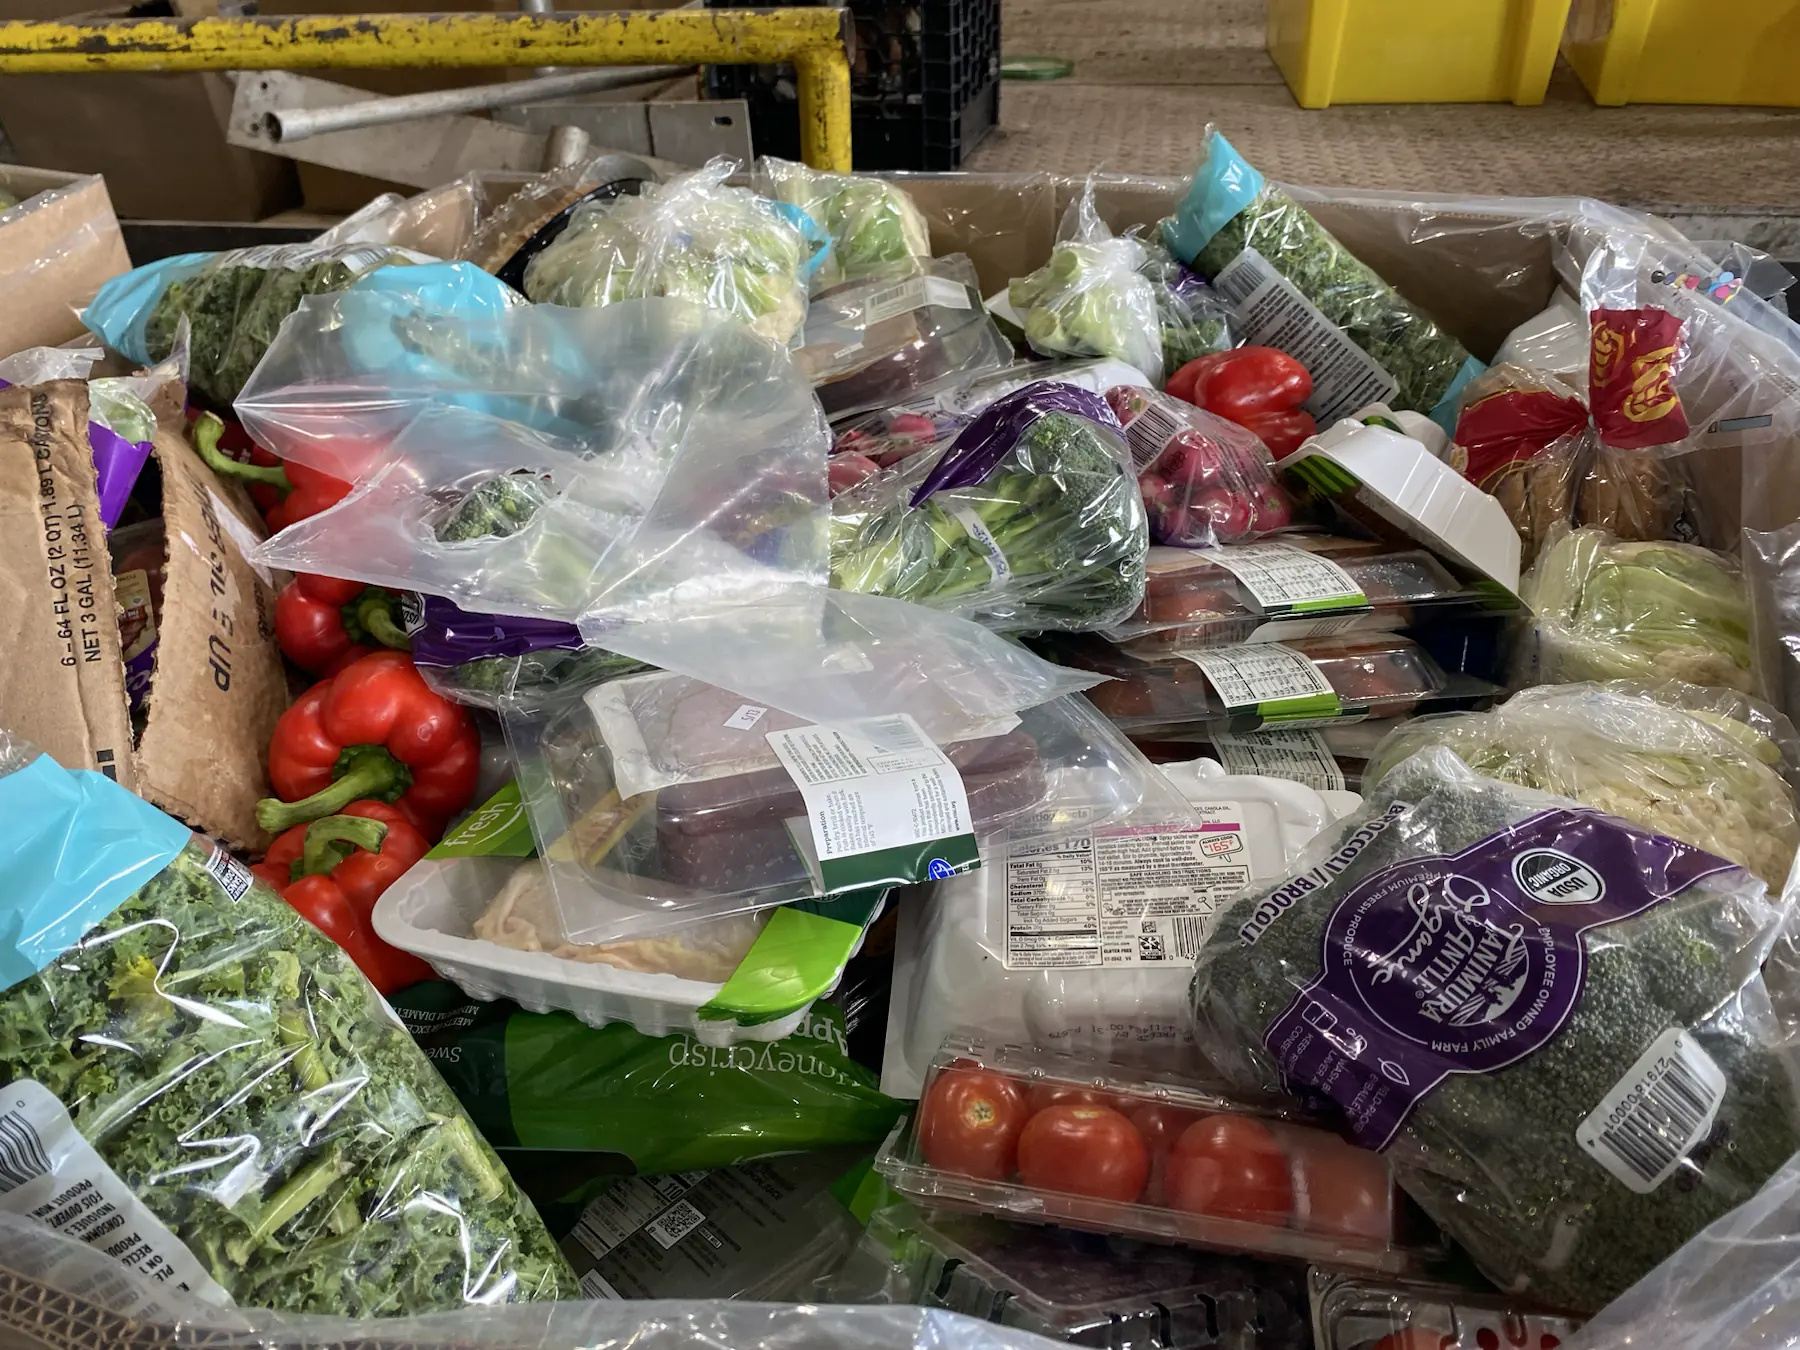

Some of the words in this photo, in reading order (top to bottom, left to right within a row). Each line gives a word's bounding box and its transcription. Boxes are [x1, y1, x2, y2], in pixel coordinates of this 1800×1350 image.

[40, 464, 52, 475] L
[40, 478, 56, 508] 1.89
[66, 504, 84, 521] L)
[45, 515, 62, 542] QT)
[48, 545, 67, 560] (2
[71, 523, 93, 569] (11.34
[50, 564, 66, 589] OZ
[76, 574, 95, 606] GAL
[53, 593, 69, 615] FL
[81, 608, 96, 623] 3
[57, 621, 72, 638] 64
[83, 629, 101, 663] NET
[61, 656, 76, 666] 6
[209, 634, 231, 692] UP
[444, 802, 512, 847] fresh
[820, 811, 833, 854] Preparation
[1389, 872, 1442, 892] PREMIUM
[1528, 862, 1572, 888] ORGANIC
[1546, 876, 1588, 898] USDA
[1361, 890, 1390, 916] FRESH
[1344, 914, 1368, 966] PRODUCE
[1371, 874, 1490, 986] Organic
[1538, 926, 1556, 988] EMPLOYEE
[1418, 918, 1524, 1024] TANIMURA
[1516, 989, 1550, 1030] OWNED
[1296, 1032, 1314, 1055] KEEP
[1432, 1040, 1469, 1052] FARM
[1472, 1024, 1516, 1052] FAMILY
[1674, 1040, 1683, 1048] 0
[1328, 1058, 1348, 1084] WASH
[1586, 1139, 1596, 1148] 4
[51, 1178, 93, 1206] PRODUIT
[84, 1190, 104, 1210] FOIS
[662, 1182, 684, 1200] 110
